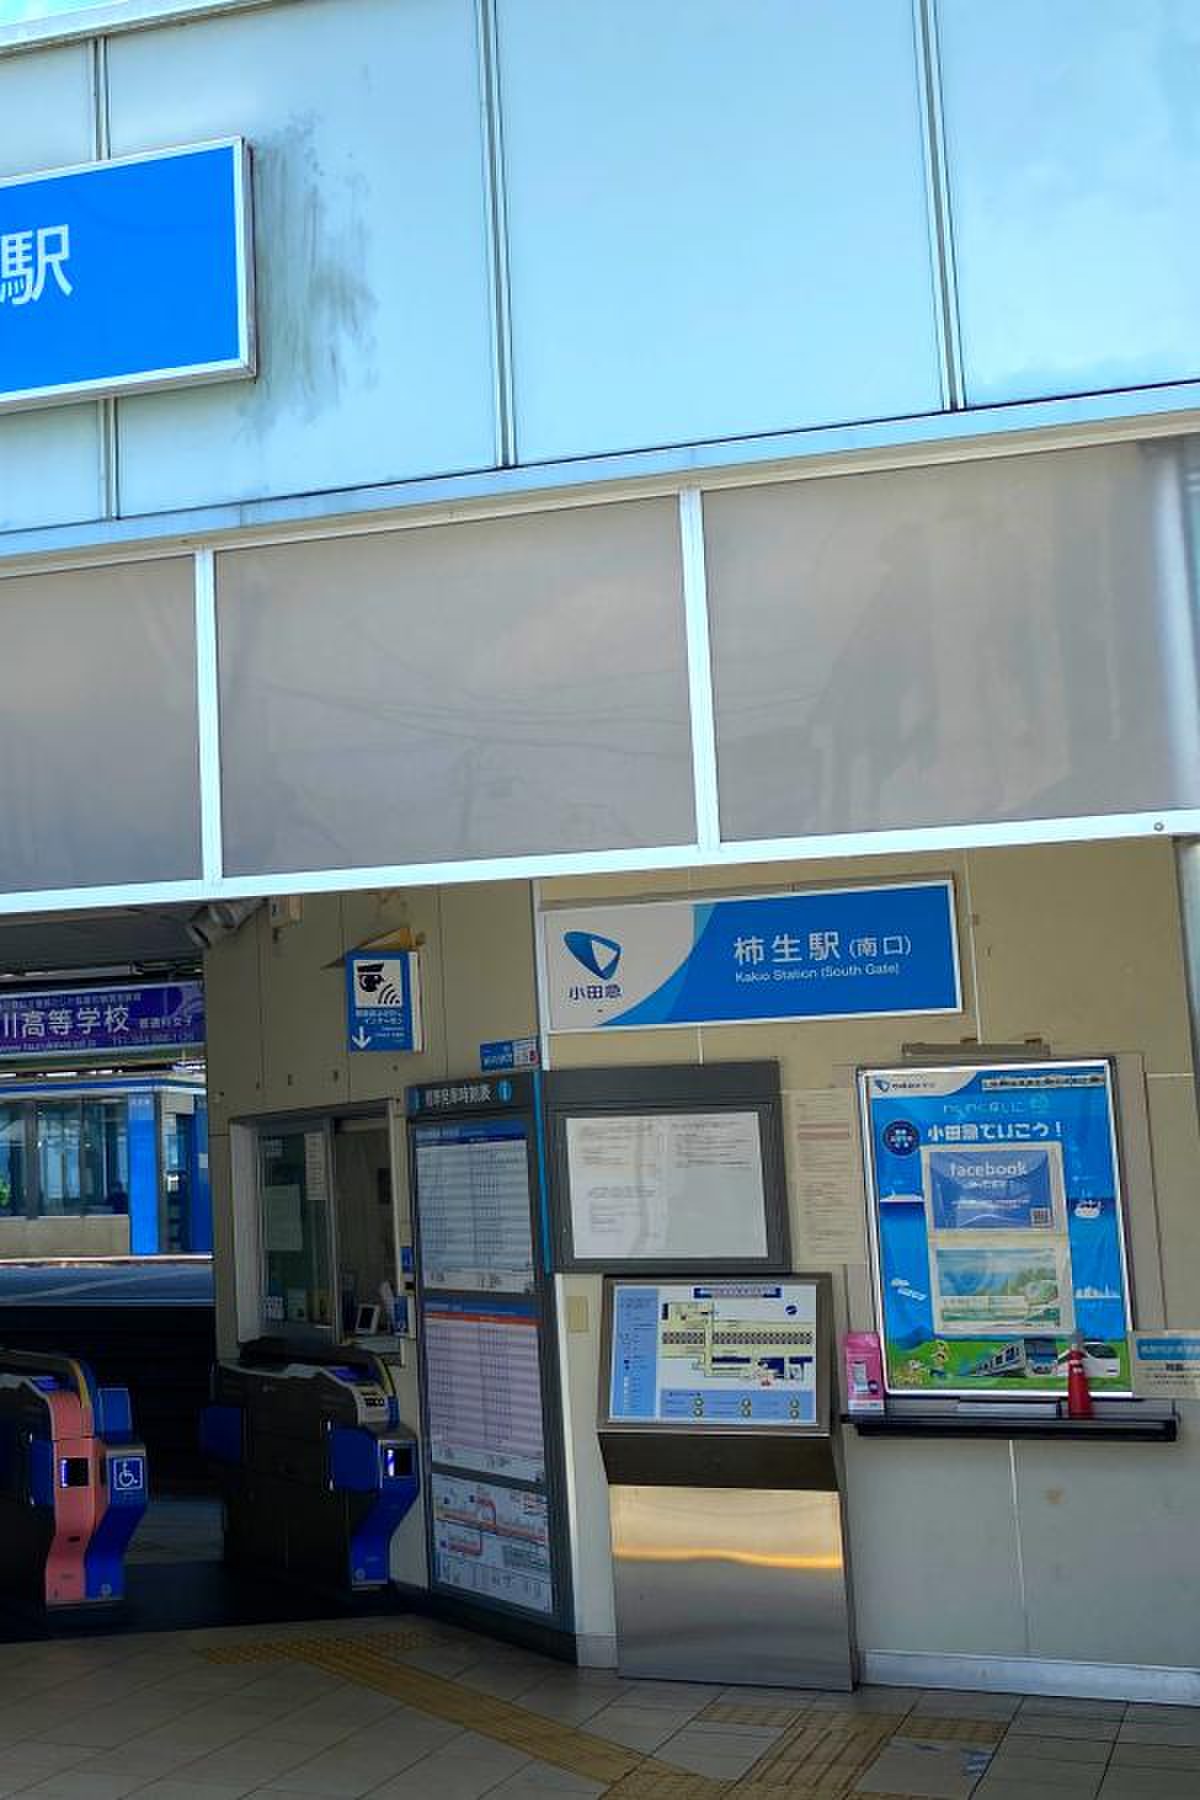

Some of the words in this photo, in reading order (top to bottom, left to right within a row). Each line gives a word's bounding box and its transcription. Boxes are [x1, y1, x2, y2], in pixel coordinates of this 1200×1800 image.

[735, 970, 771, 983] Kakio
[773, 968, 817, 982] Station
[821, 964, 863, 978] (South
[865, 962, 900, 976] Gate)
[569, 984, 622, 1001] 小田急
[949, 1160, 1028, 1177] facebook
